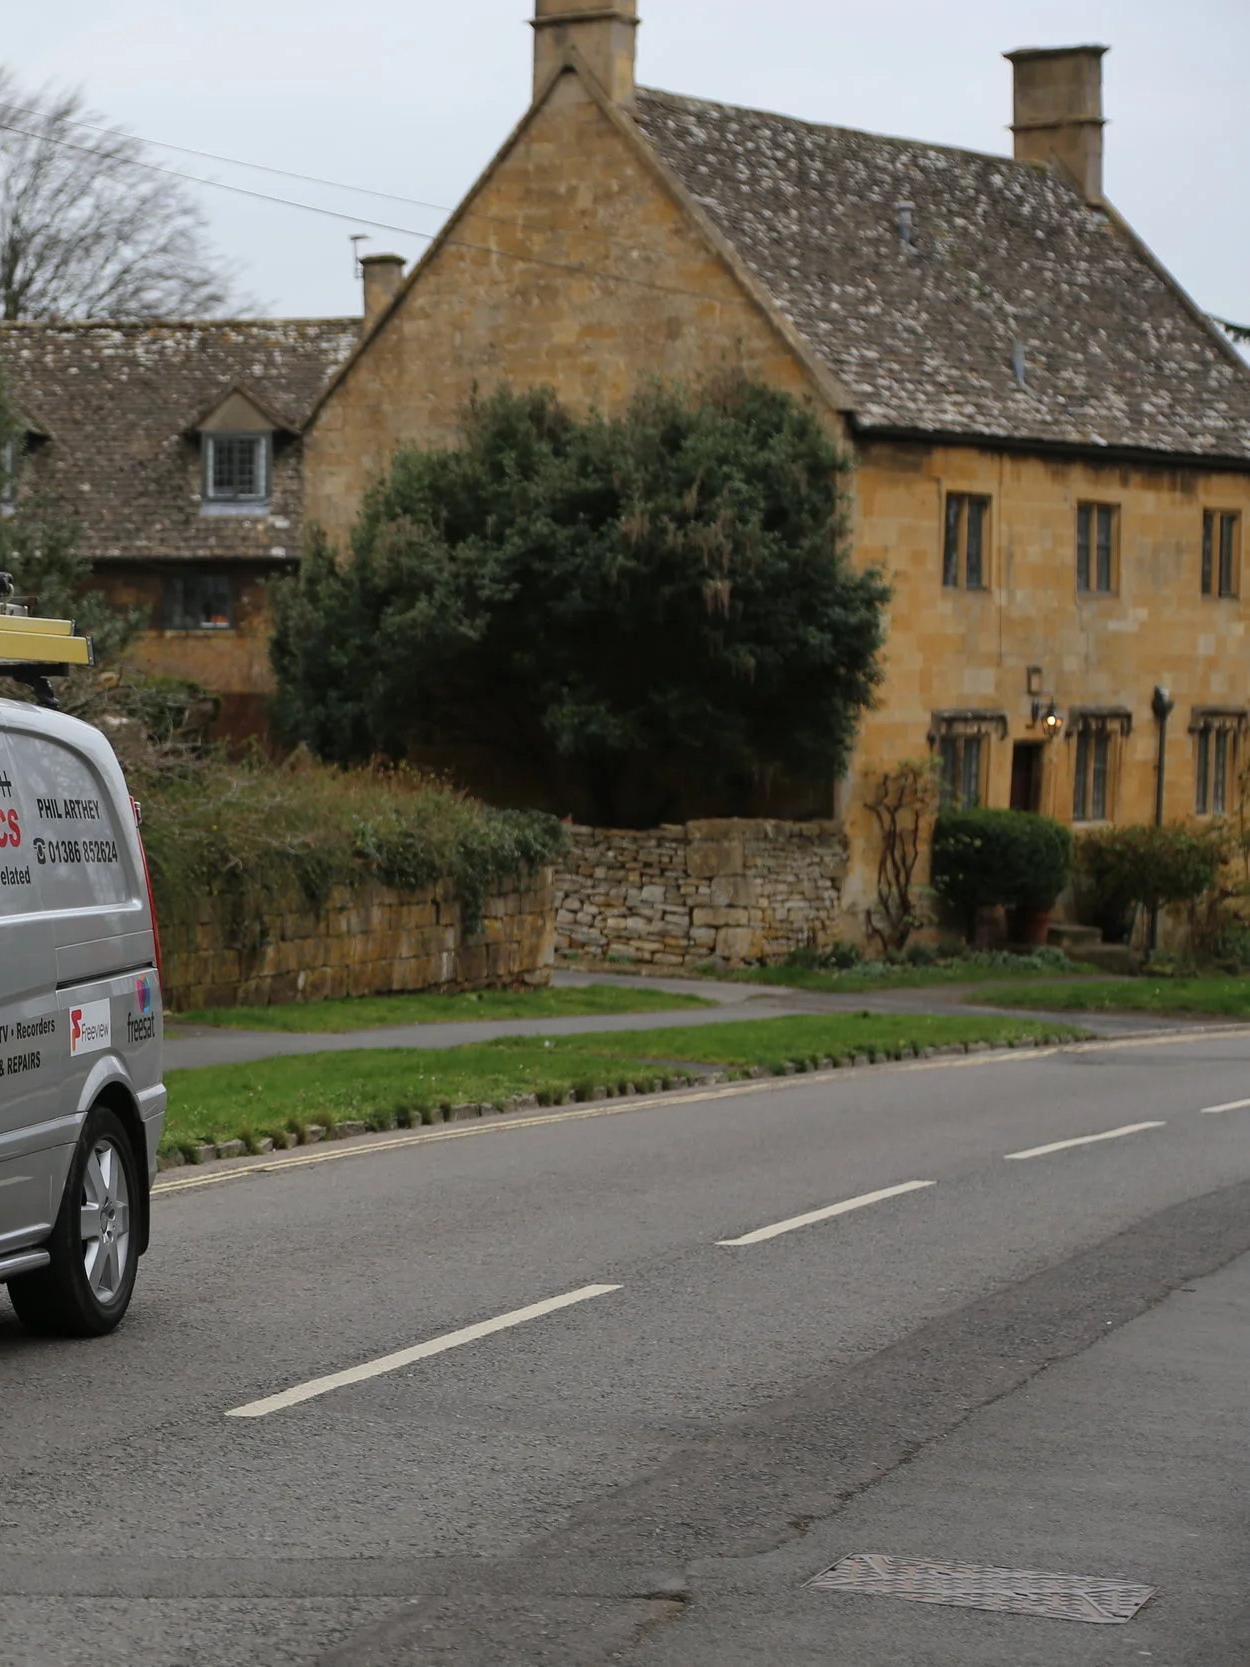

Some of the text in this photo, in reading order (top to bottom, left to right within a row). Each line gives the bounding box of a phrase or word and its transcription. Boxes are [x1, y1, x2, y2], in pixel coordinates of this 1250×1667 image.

[36, 798, 100, 820] PHIL ARTHEY
[48, 840, 118, 864] 01386 852624
[16, 1017, 56, 1040] Recorders
[81, 1021, 110, 1042] Freeview
[127, 1011, 155, 1044] freesat
[7, 1050, 41, 1076] REPAIRS
